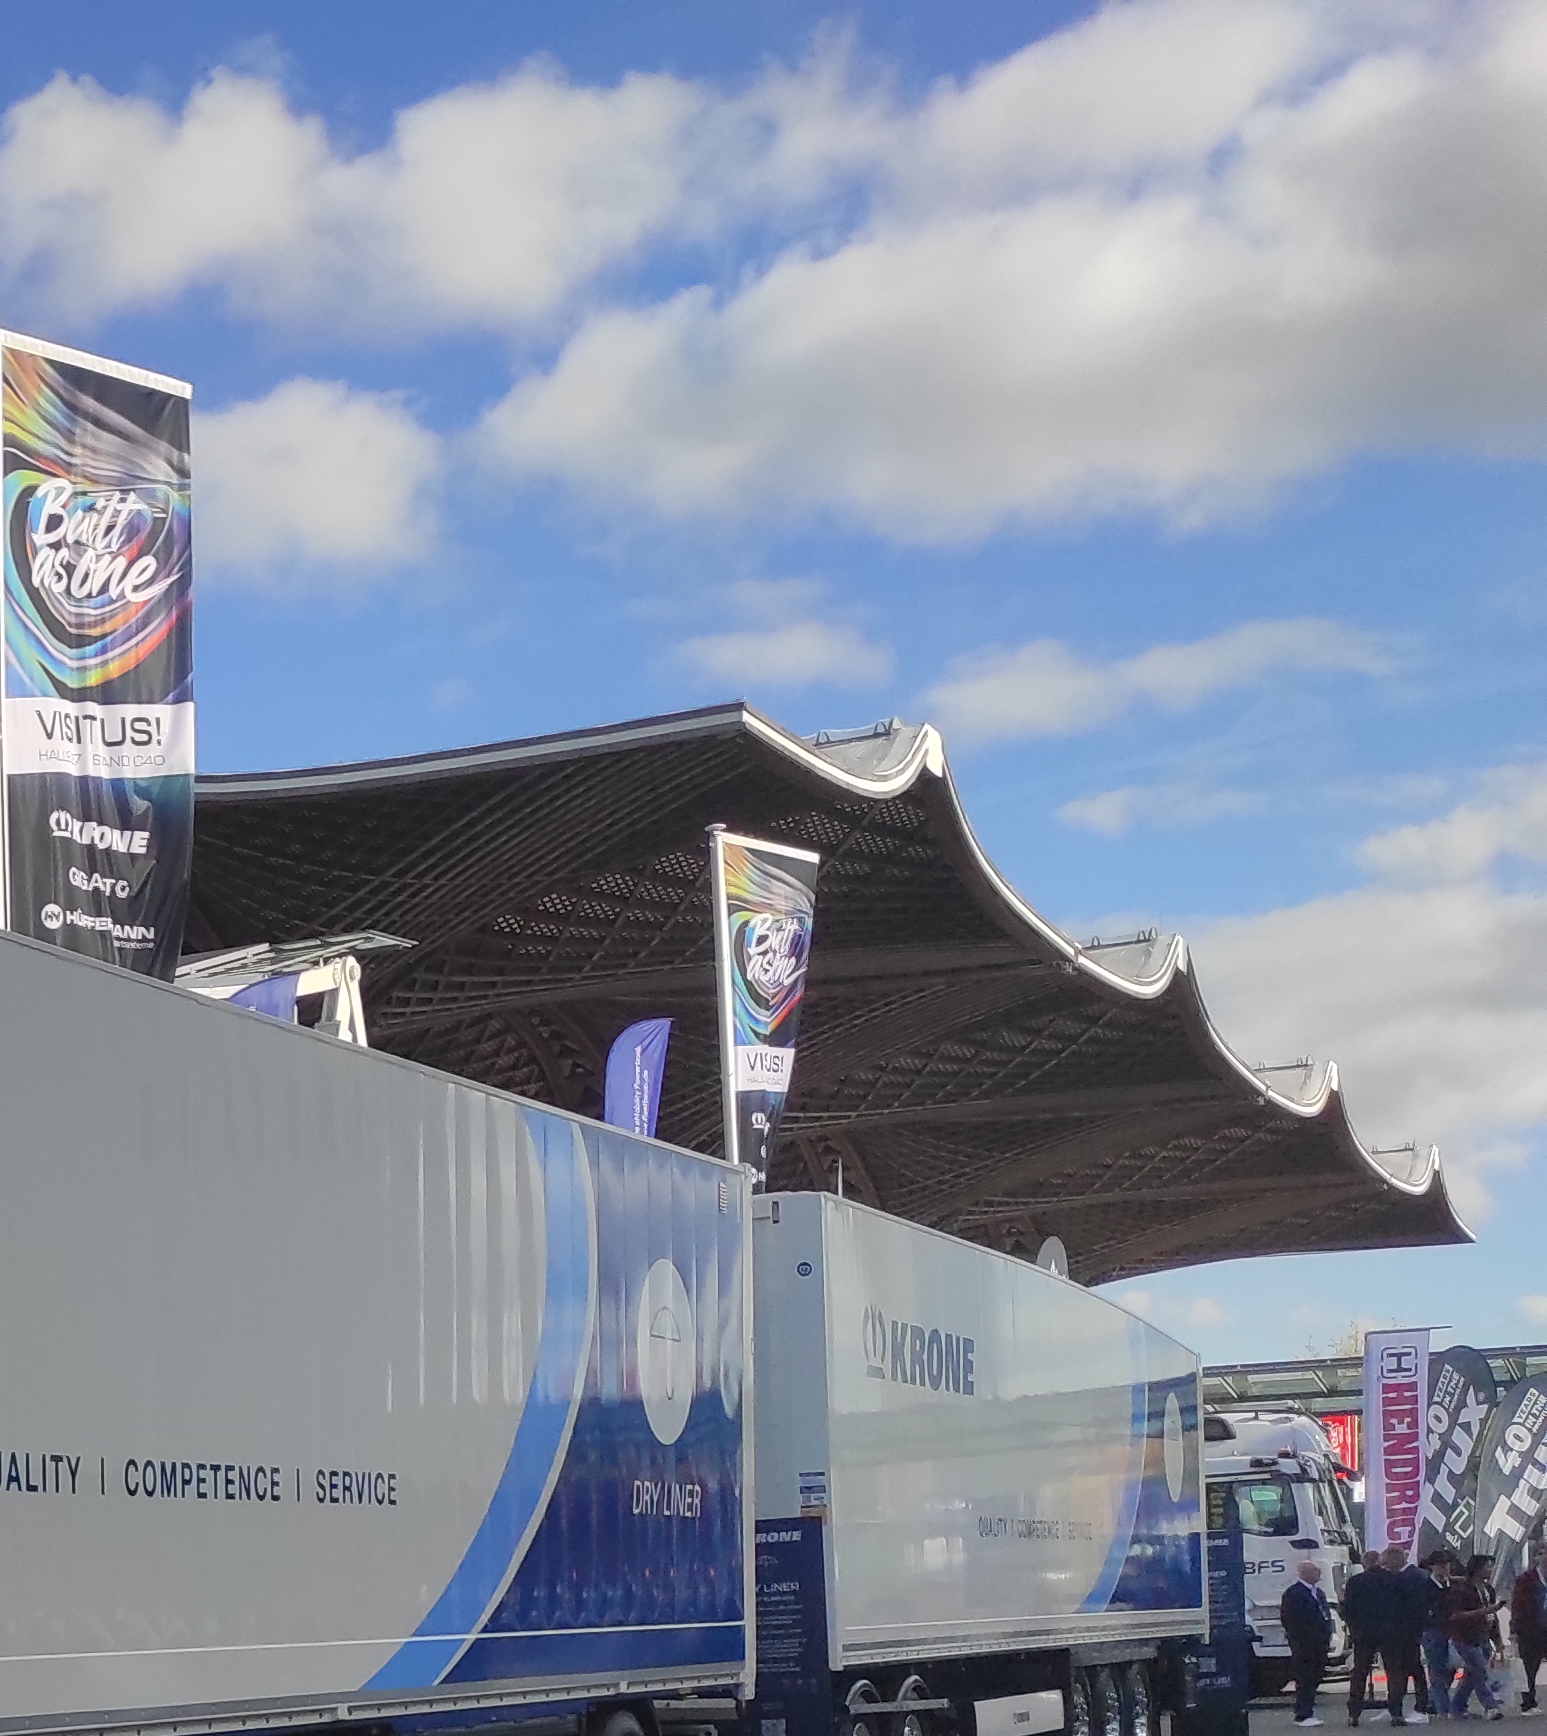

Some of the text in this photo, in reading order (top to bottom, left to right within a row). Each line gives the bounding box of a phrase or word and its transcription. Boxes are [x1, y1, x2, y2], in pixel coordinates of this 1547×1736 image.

[32, 548, 182, 602] as one
[35, 710, 162, 747] VISIT US!
[891, 1320, 975, 1397] KRONE
[1515, 1389, 1537, 1423] YEARS
[1382, 1381, 1420, 1556] HENDRIC
[1495, 1424, 1533, 1475] 40
[123, 1459, 282, 1503] COMPETENCE
[315, 1470, 399, 1507] SERVICE
[633, 1480, 702, 1518] DRY LINER
[756, 1530, 802, 1543] RONE
